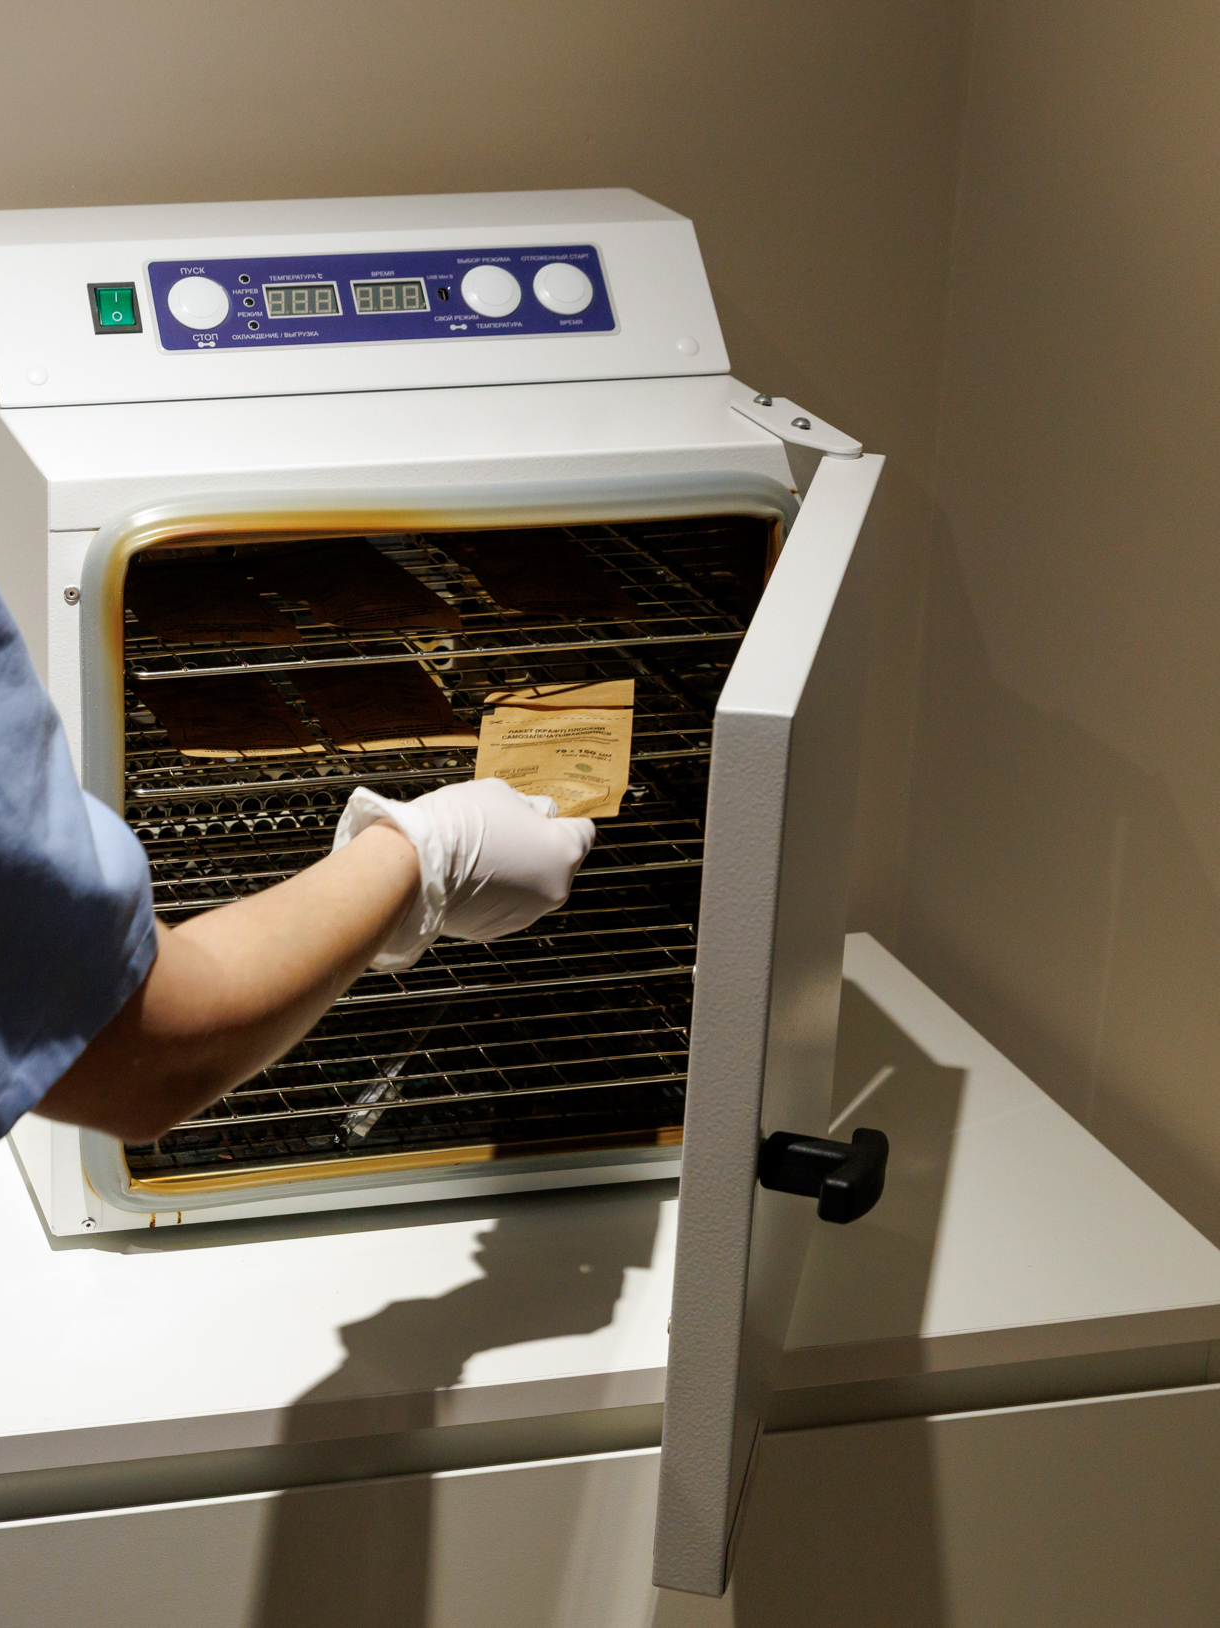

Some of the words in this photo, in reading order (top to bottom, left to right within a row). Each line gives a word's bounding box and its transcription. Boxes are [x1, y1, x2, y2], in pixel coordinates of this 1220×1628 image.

[180, 267, 205, 275] ПУСК
[269, 273, 317, 281] ТЕМПЕРАТУРА
[232, 287, 259, 295] НАГРЕВ
[237, 310, 263, 318] РЕЖИМ
[433, 314, 453, 322] СВОЙ
[475, 321, 523, 329] ТЕМПЕРАТУРА
[192, 333, 219, 341] СТОП
[232, 332, 279, 340] ОХЛАЖДЕНИЕ
[284, 330, 319, 338] ВЫГРУЗКА
